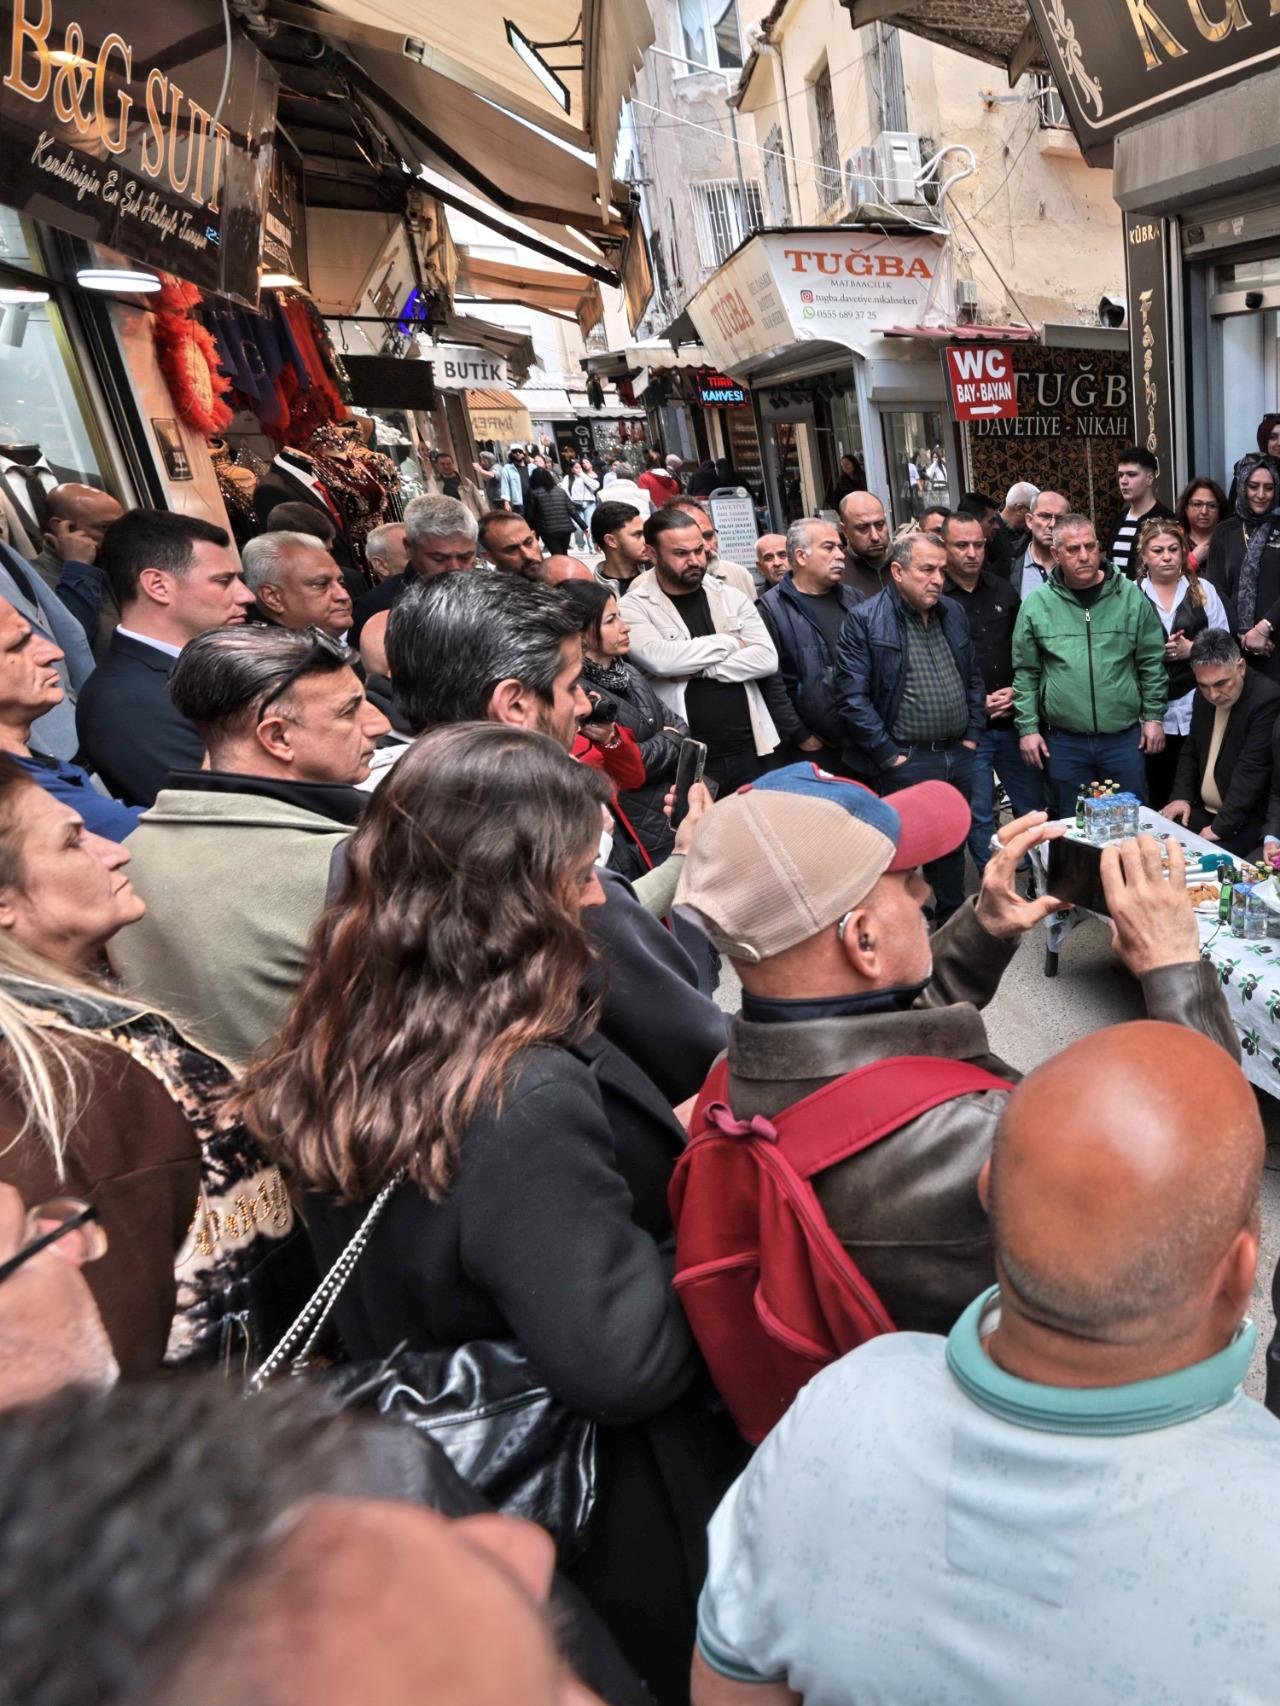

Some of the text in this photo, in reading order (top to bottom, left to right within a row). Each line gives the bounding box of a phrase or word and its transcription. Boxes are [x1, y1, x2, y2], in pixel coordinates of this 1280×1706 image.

[3, 0, 133, 154] B&G
[140, 67, 231, 215] SUIT
[102, 169, 120, 206] En
[1129, 224, 1160, 244] KÜBRA
[784, 247, 933, 279] TUĞBA
[830, 279, 893, 289] MATBAACILIK
[816, 310, 878, 320] 0555 689 37 25
[445, 359, 503, 381] BUTİK
[952, 349, 1006, 380] WC
[702, 389, 744, 401] KAHVESİ
[977, 411, 1061, 436] DAVETİYE
[1076, 411, 1128, 436] NİKAH
